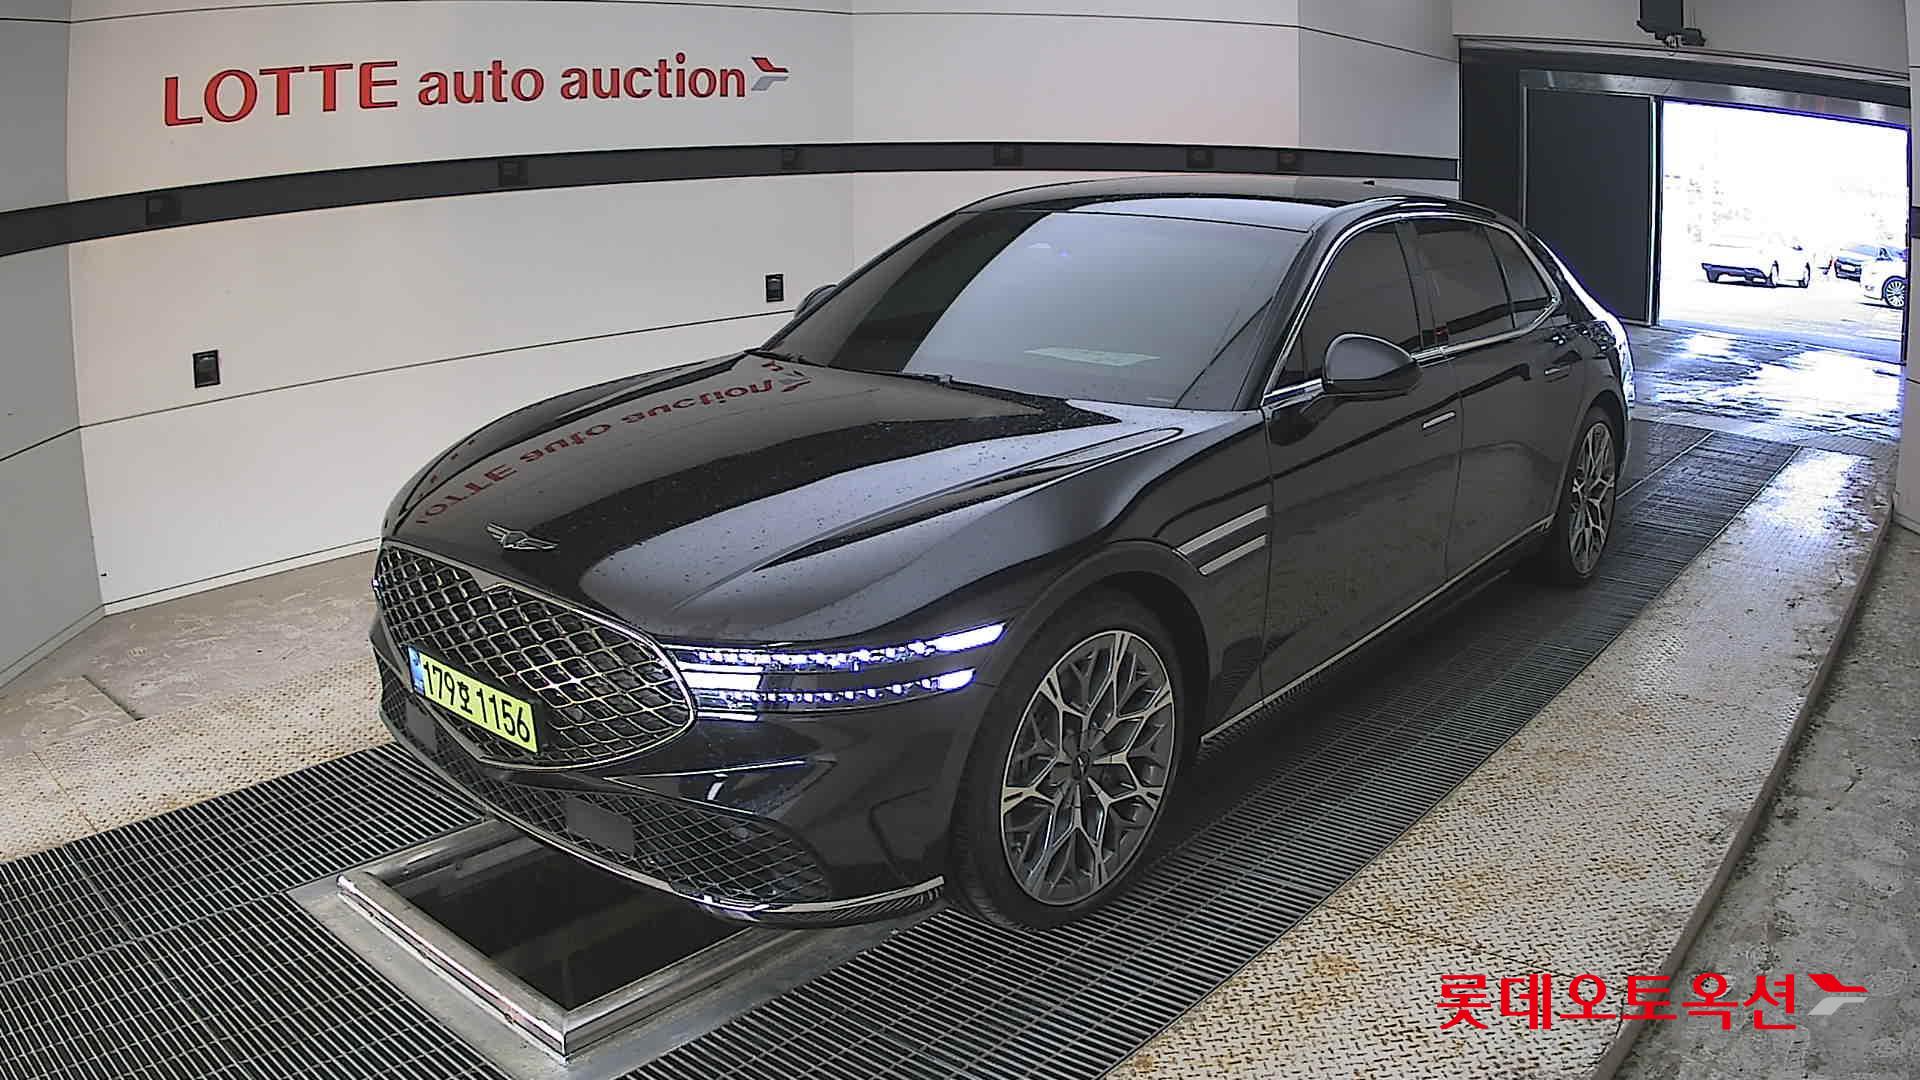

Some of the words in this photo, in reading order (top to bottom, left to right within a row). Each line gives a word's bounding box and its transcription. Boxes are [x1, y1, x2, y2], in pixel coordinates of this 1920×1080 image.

[164, 60, 399, 127] LOTTE
[417, 59, 545, 107] auto
[560, 51, 747, 100] auction
[476, 687, 530, 743] 1156
